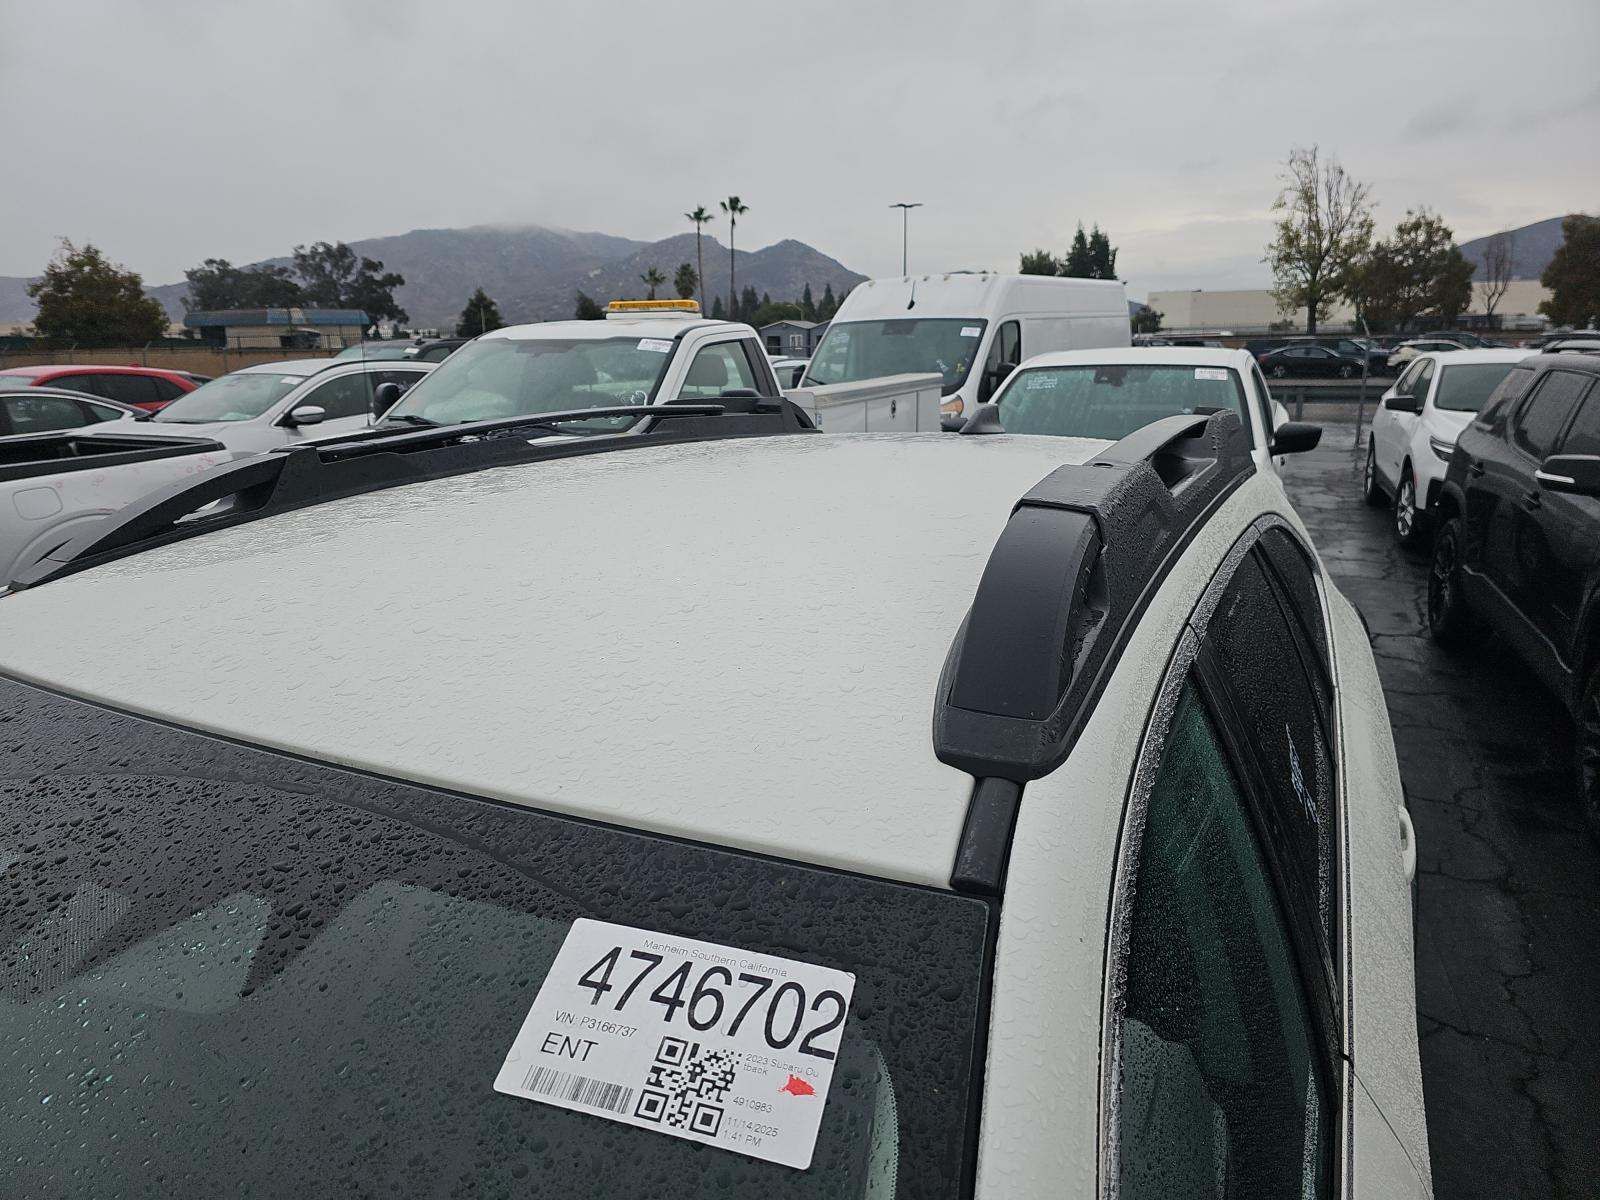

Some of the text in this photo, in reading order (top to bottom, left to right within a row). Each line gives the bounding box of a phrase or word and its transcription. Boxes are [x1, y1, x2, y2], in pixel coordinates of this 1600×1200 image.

[644, 940, 788, 977] Manheim Southern California
[577, 946, 847, 1060] 4746702
[580, 1016, 637, 1038] P3166737
[540, 1032, 599, 1062] ENT
[743, 1063, 769, 1076] tback
[745, 1053, 769, 1066] 2023
[770, 1059, 803, 1074] Subaru
[744, 1134, 763, 1148] PM
